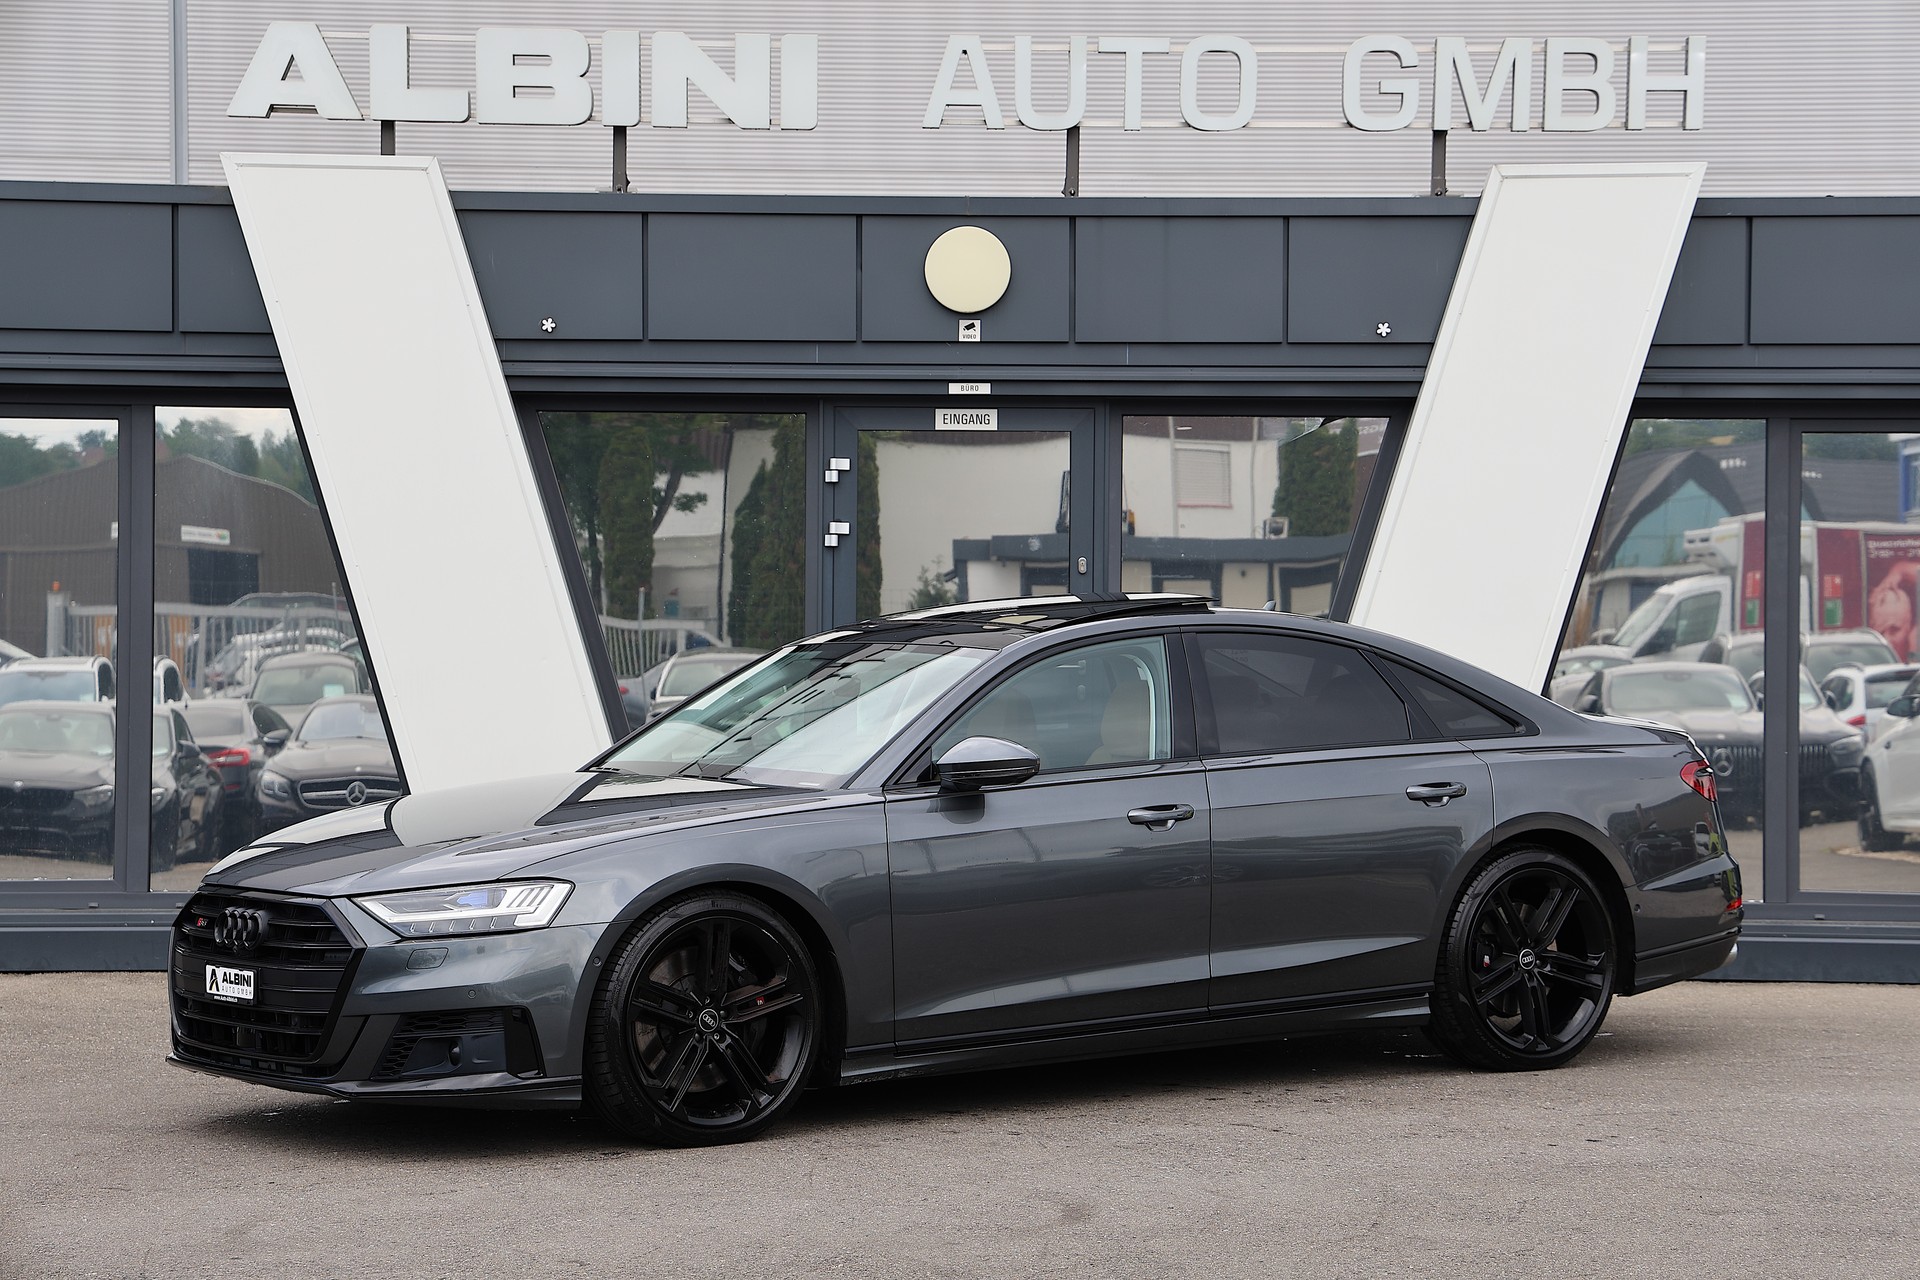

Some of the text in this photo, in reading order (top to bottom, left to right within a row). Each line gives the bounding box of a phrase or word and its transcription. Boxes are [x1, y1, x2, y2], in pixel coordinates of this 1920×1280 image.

[226, 21, 1707, 132] ALBINI AUTO GMBH
[960, 384, 979, 392] BÜRO
[942, 413, 991, 425] EINGANG
[222, 971, 252, 988] ALBINI
[222, 985, 252, 997] AUTO GMBH
